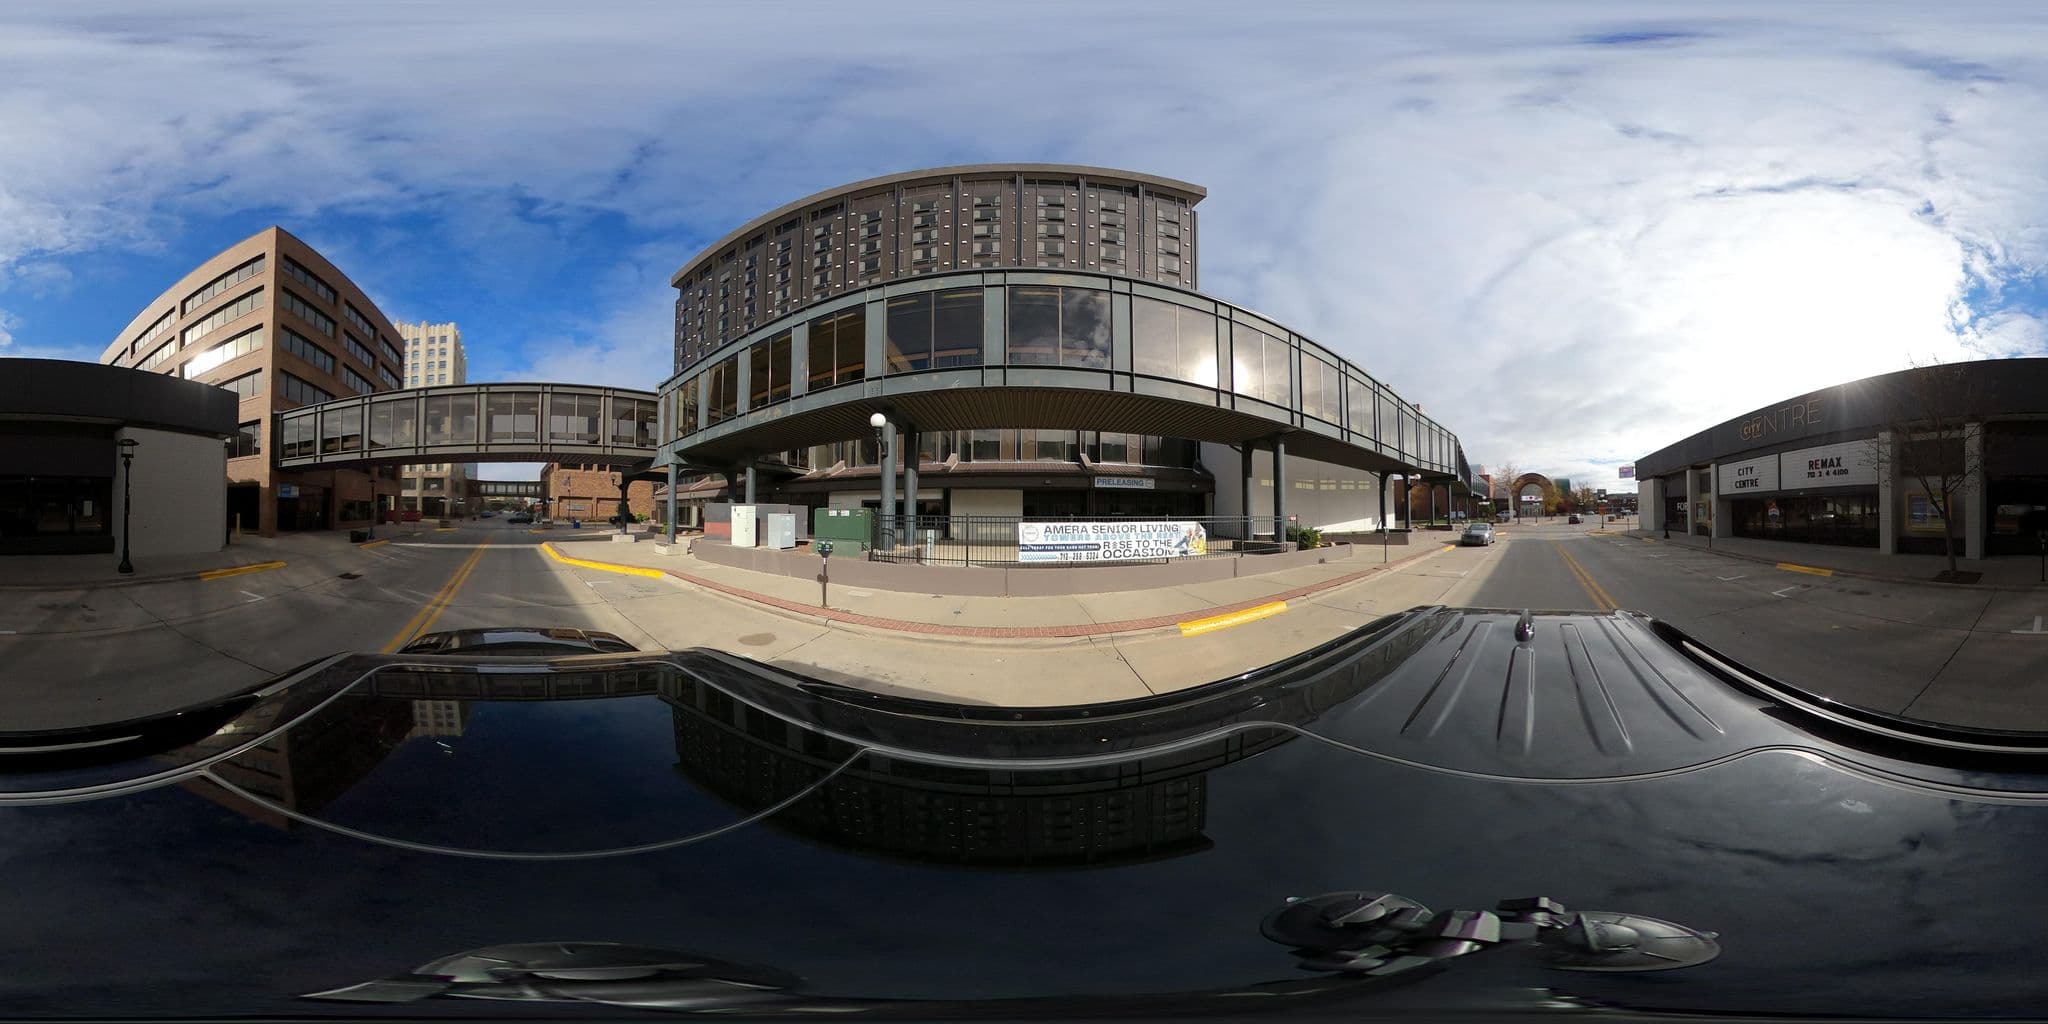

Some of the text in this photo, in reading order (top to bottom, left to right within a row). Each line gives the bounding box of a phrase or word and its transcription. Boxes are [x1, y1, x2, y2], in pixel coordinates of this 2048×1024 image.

[1808, 456, 1842, 471] REMAX
[1737, 466, 1754, 477] CITY
[1096, 478, 1145, 487] PRELEASING
[1735, 478, 1760, 489] CENTRE
[1044, 525, 1088, 534] AMERA
[1092, 524, 1137, 534] SENIOR
[1140, 524, 1179, 533] LIVING
[1043, 534, 1091, 542] TOWERS
[1095, 533, 1130, 541] ABOVE
[1136, 532, 1153, 540] THE
[1136, 540, 1150, 548] TO
[1152, 539, 1172, 547] THE
[1103, 548, 1174, 559] OCCASION
